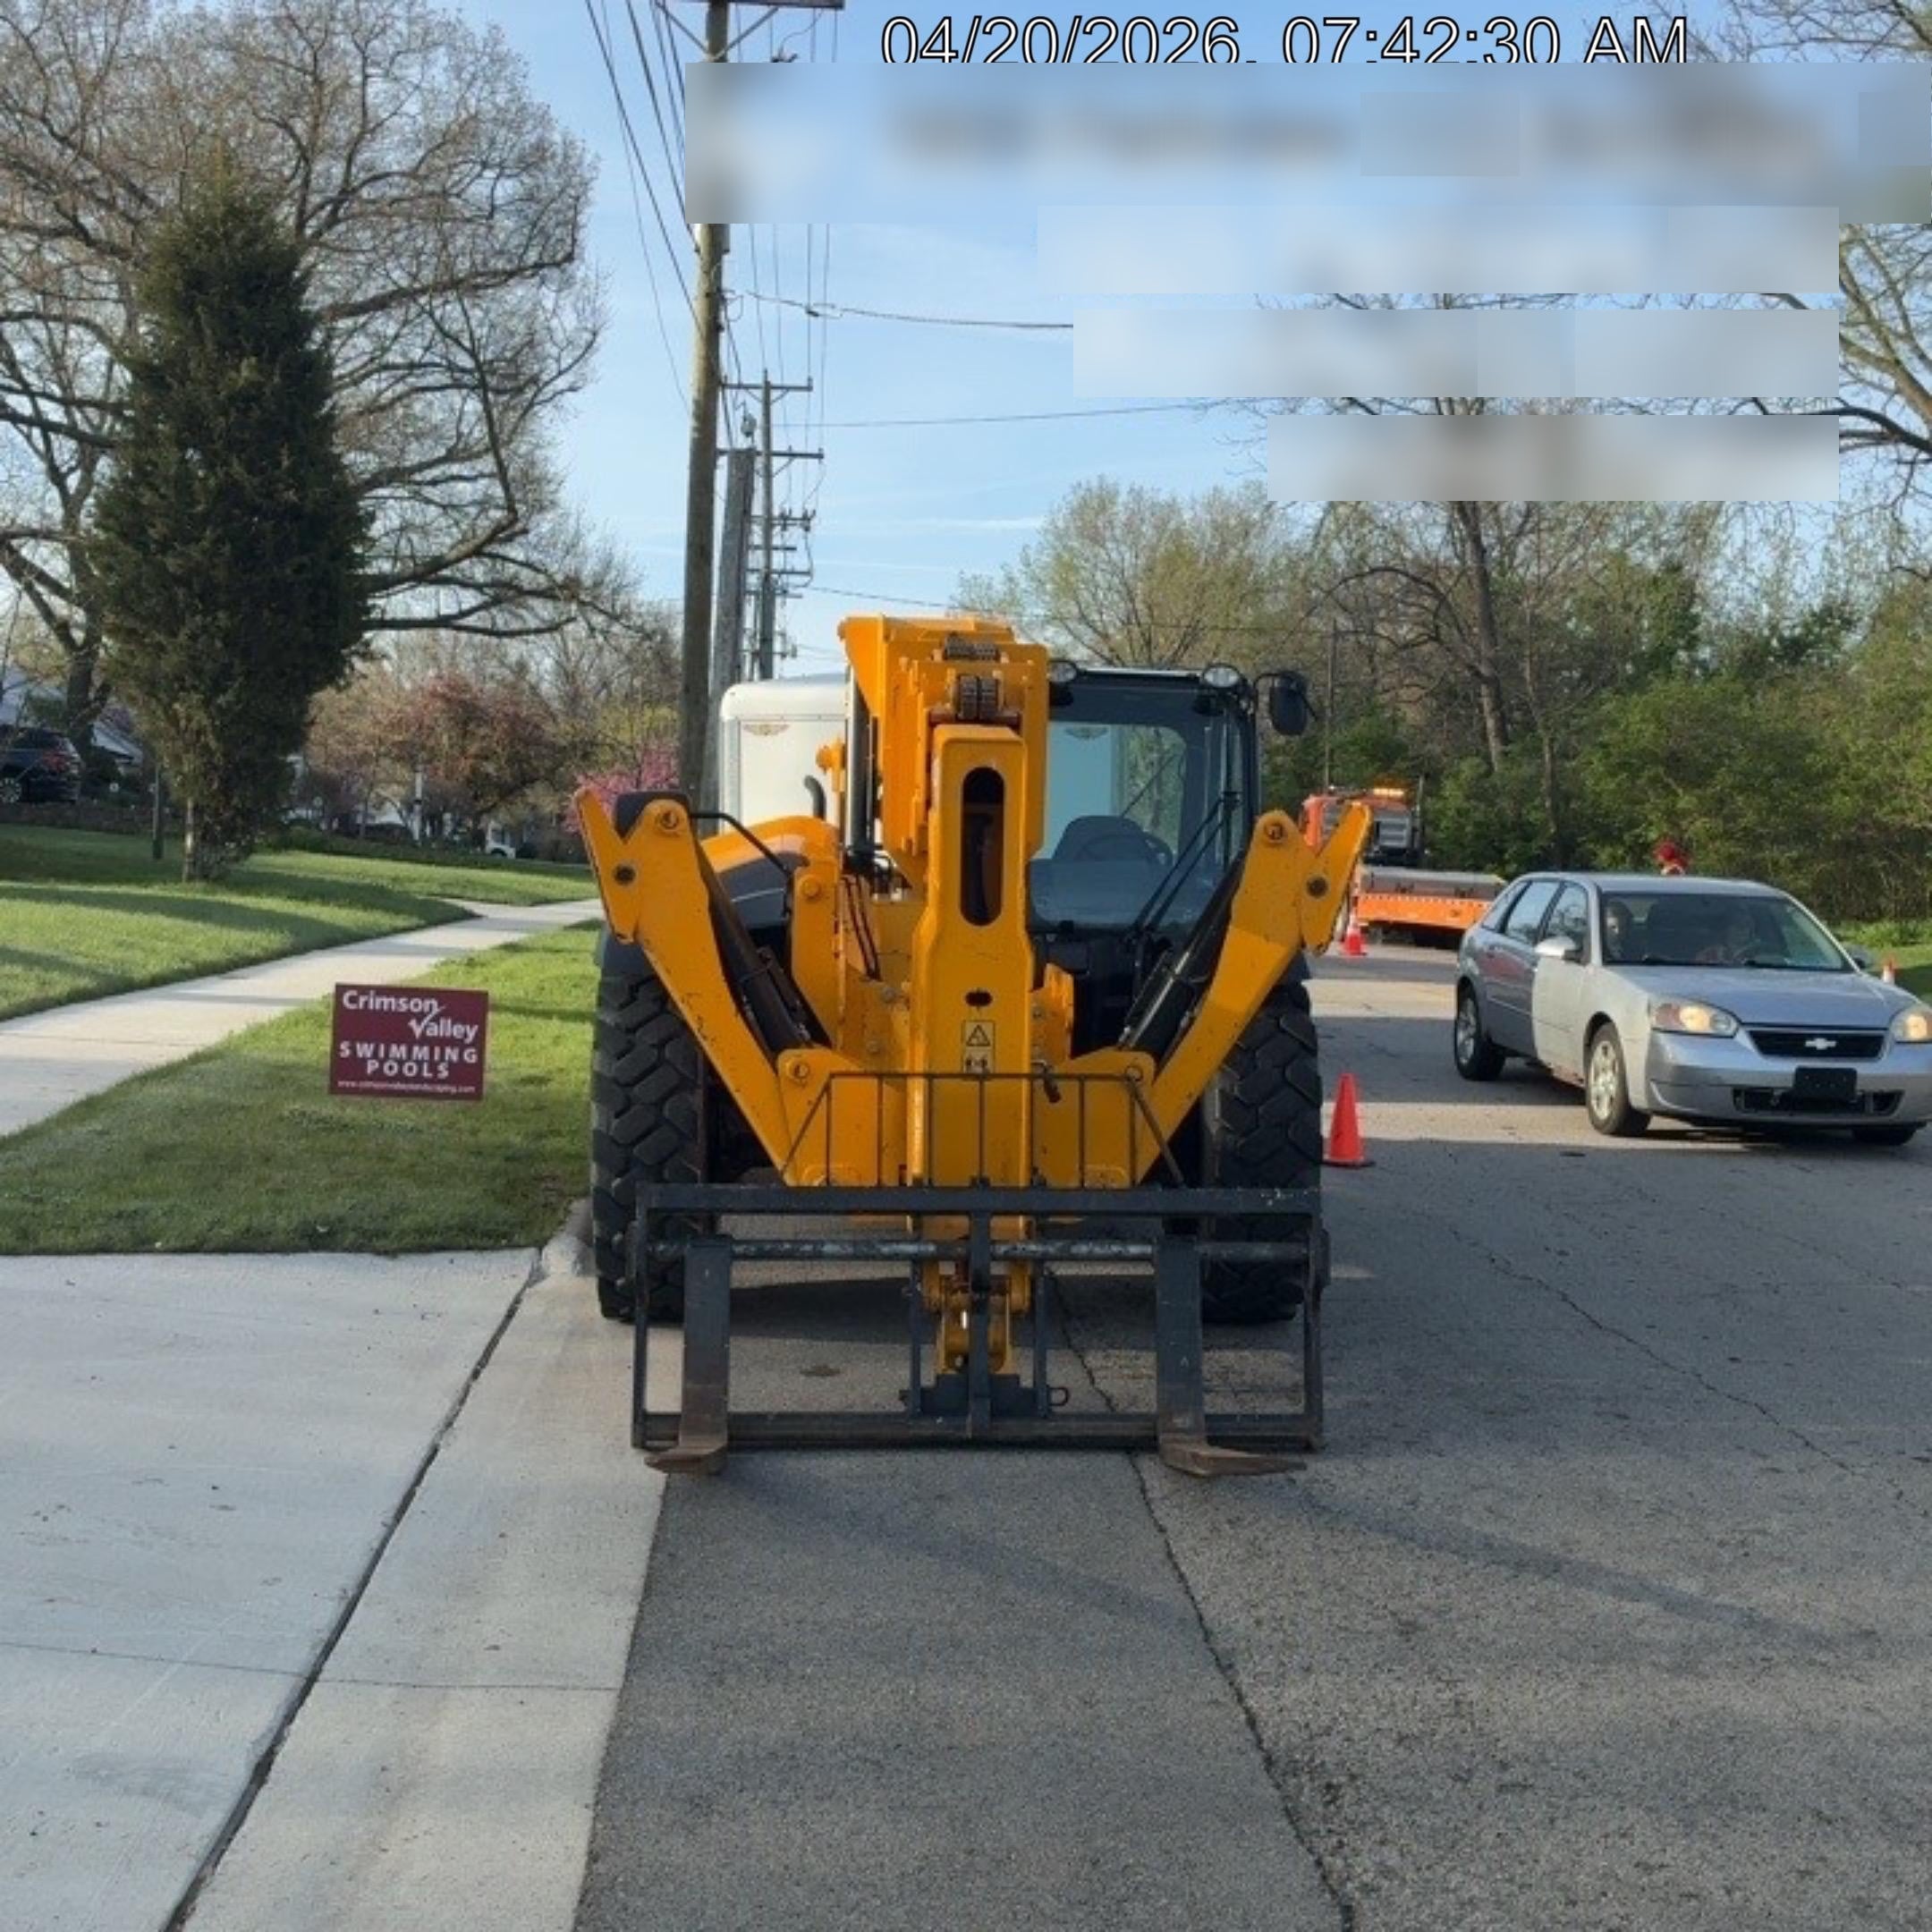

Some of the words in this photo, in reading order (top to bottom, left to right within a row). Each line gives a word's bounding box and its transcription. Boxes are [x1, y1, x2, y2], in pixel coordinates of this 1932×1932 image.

[343, 990, 439, 1013] Crimson
[408, 1006, 479, 1044] Valley
[339, 1041, 479, 1063] SWIMMING
[367, 1059, 450, 1080] POOLS
